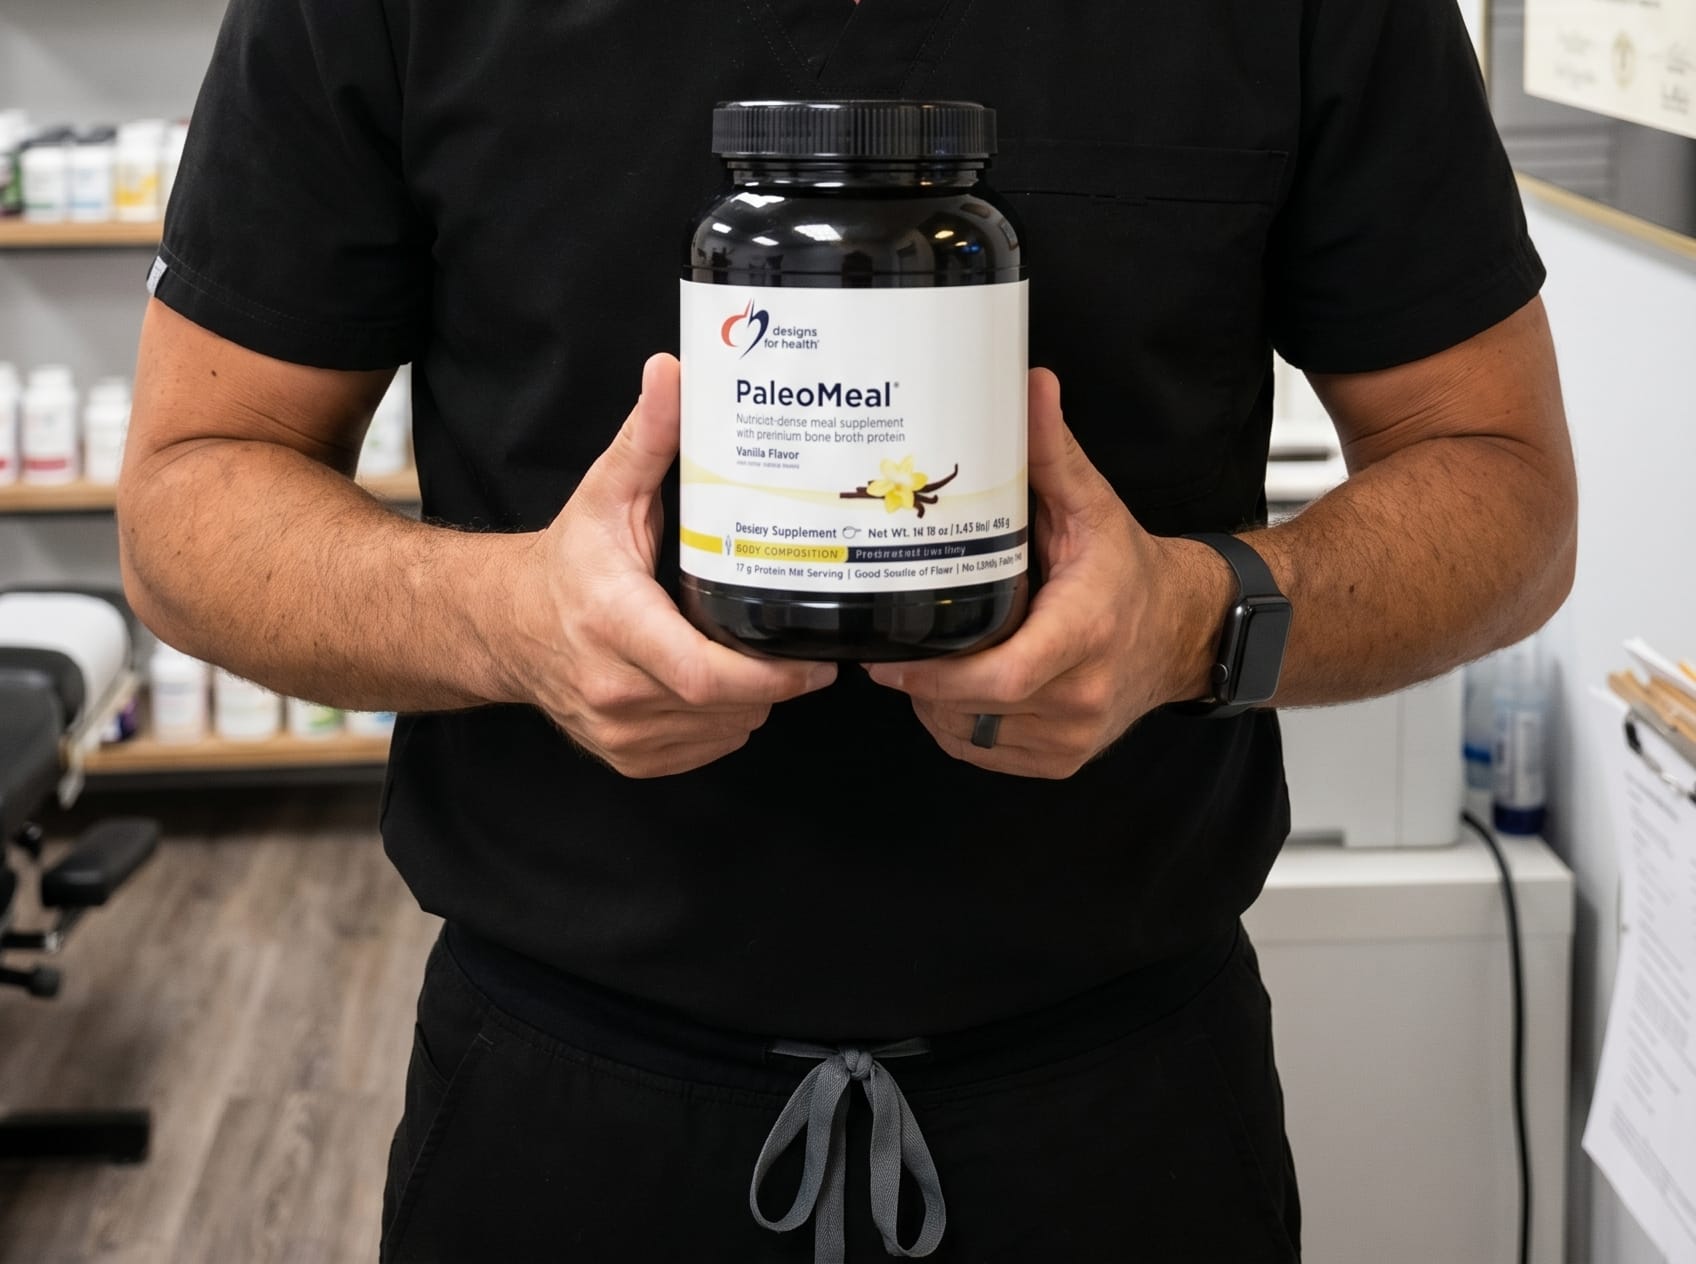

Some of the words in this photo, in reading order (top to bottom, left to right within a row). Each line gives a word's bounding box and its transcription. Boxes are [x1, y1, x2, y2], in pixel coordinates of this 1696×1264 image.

[773, 326, 818, 339] designs
[764, 338, 778, 349] for
[810, 417, 836, 428] meal
[840, 418, 904, 430] supplement
[736, 428, 754, 438] with
[805, 431, 831, 442] bone
[834, 431, 864, 443] broth
[867, 432, 906, 444] protein
[768, 448, 800, 460] Flavor
[772, 525, 837, 539] Supplement
[868, 528, 888, 538] Net
[891, 528, 910, 538] Wt.
[938, 528, 948, 536] oz
[956, 522, 974, 534] 1.45
[764, 546, 838, 559] COMPOSITION
[736, 562, 744, 572] 17
[746, 566, 752, 574] g
[754, 566, 786, 576] Protein
[807, 568, 844, 580] Serving
[854, 568, 881, 578] Good
[918, 566, 928, 576] of
[962, 562, 974, 572] No
